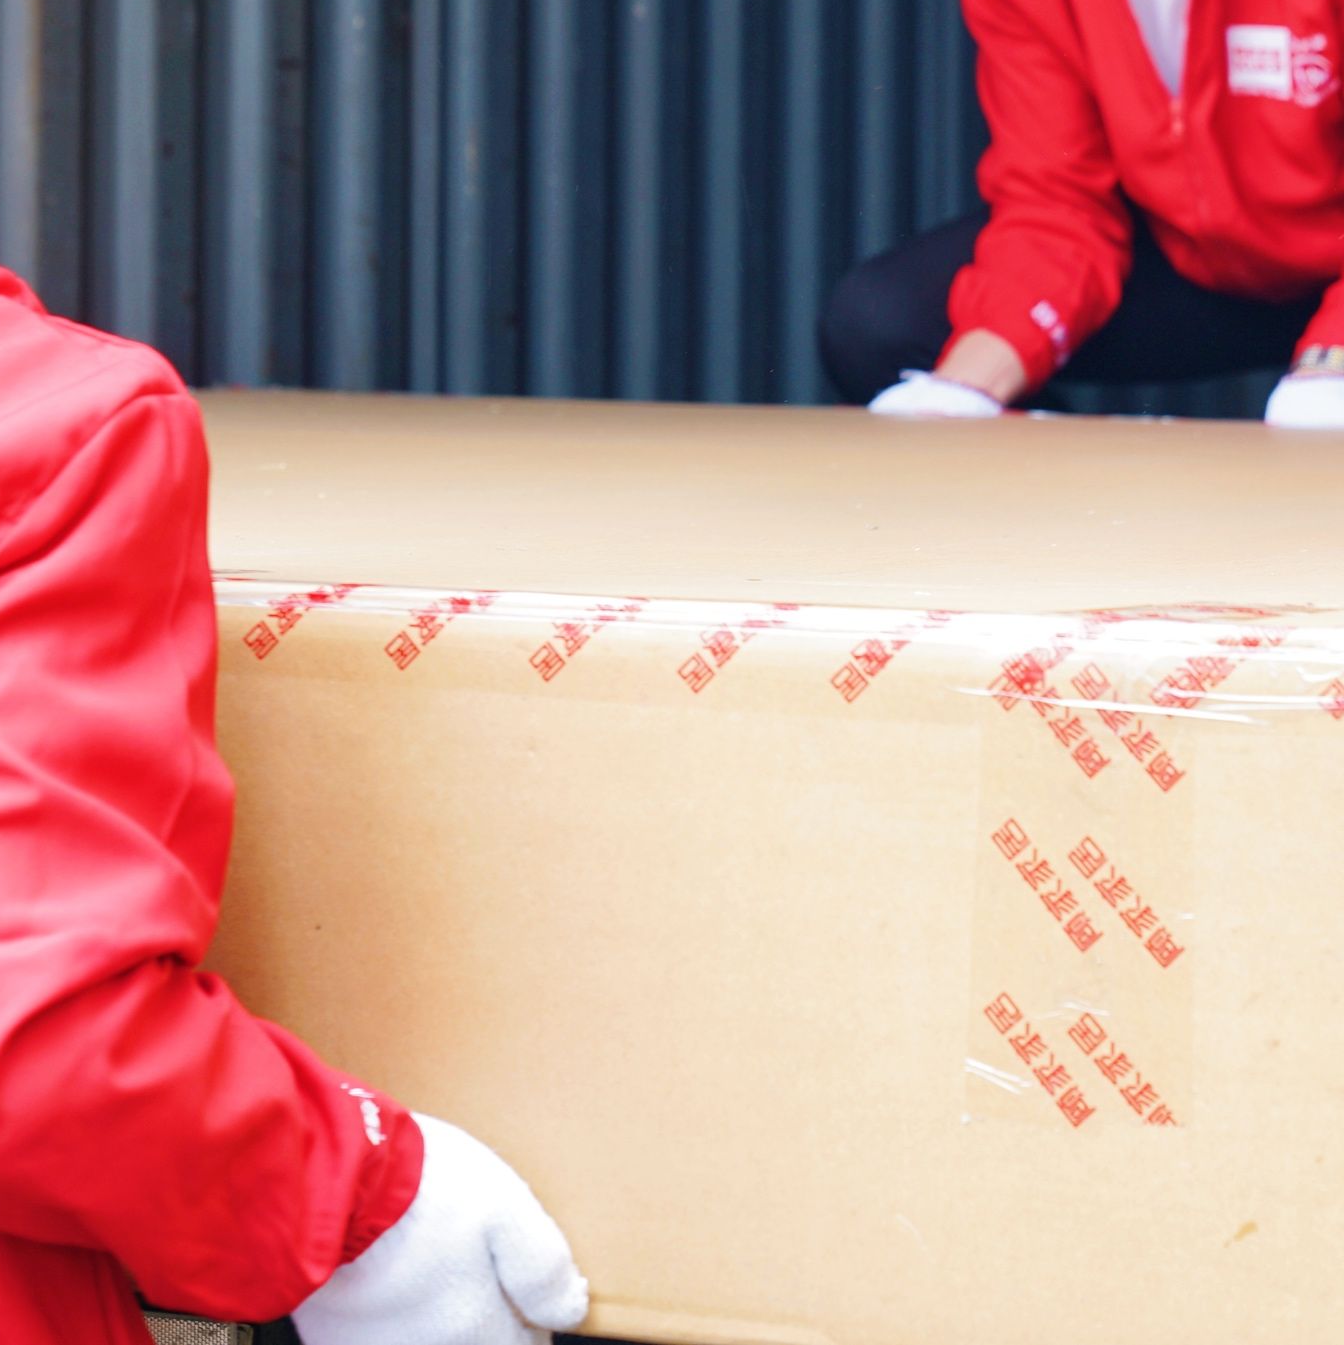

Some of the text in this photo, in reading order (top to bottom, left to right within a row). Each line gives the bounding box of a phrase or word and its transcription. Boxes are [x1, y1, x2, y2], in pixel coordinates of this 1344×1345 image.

[1070, 663, 1186, 793] 顾家家居
[990, 817, 1103, 953] 顾家家居
[1067, 835, 1185, 969] 顾家家居
[983, 991, 1096, 1128] 顾家家居
